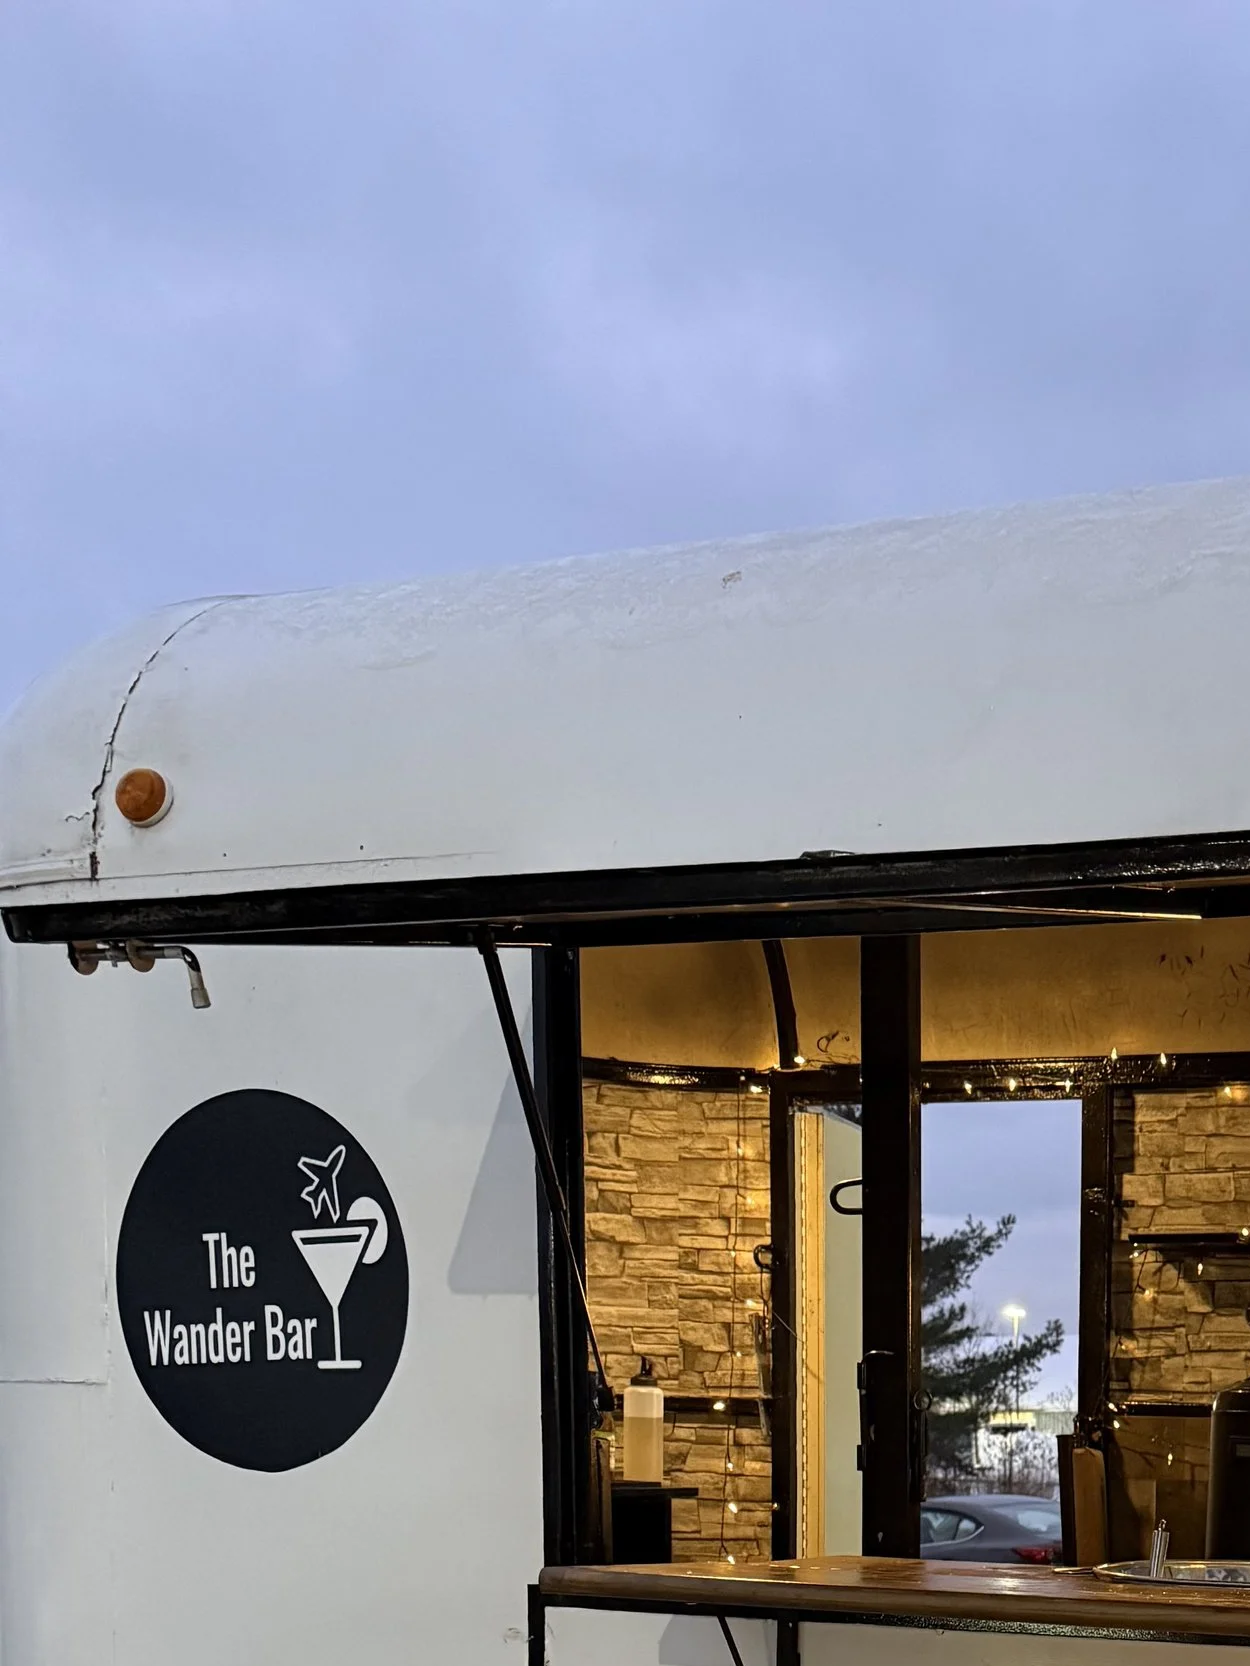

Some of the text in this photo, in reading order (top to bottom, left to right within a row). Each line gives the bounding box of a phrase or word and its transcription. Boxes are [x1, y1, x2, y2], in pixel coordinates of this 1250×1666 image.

[202, 1232, 256, 1289] The
[143, 1304, 318, 1366] Wander Bar
